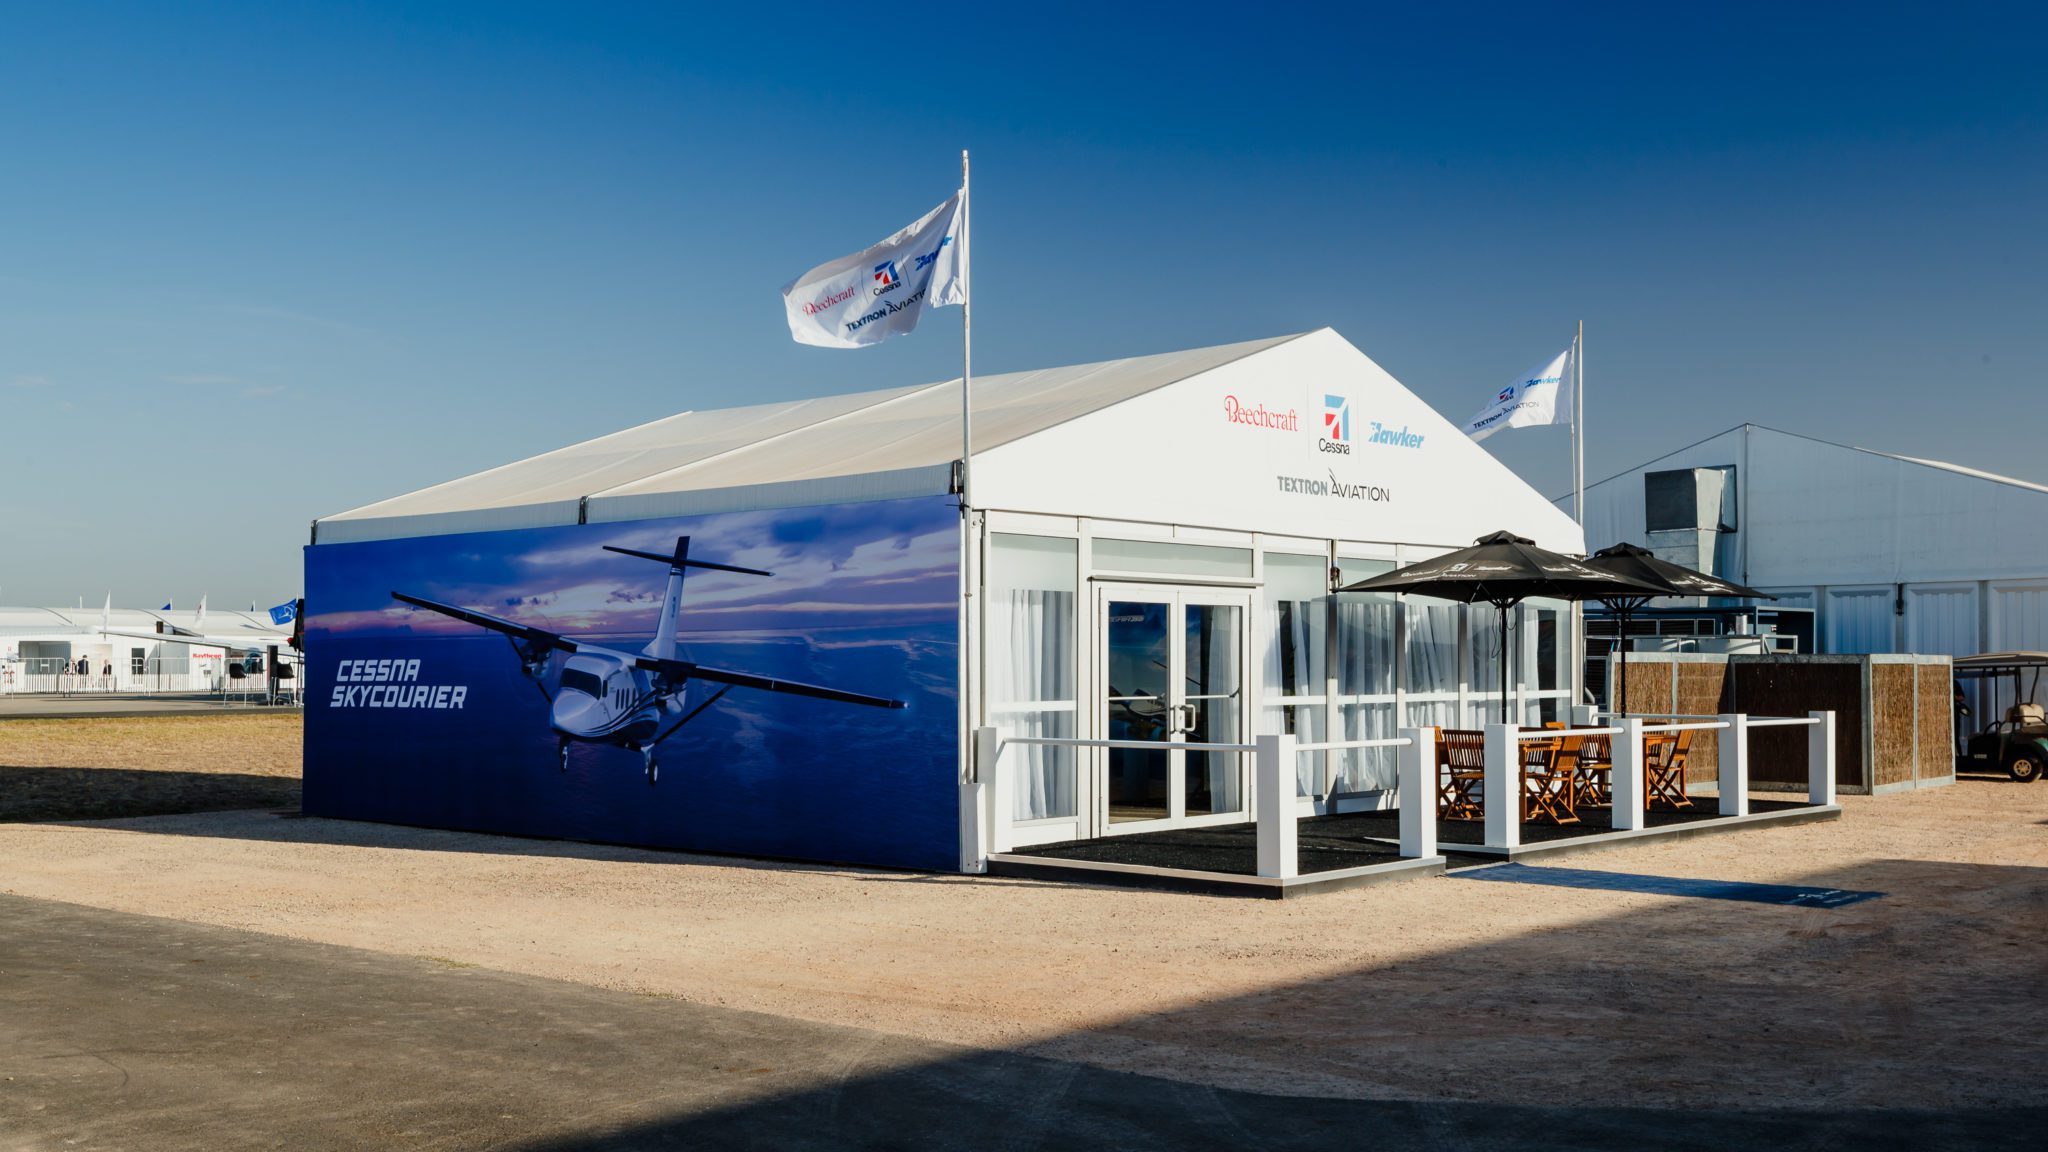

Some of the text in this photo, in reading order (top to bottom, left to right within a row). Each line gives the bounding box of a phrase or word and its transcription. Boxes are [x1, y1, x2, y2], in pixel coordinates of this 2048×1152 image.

[803, 286, 856, 317] Beechcraft
[873, 281, 901, 297] Cessna
[846, 308, 887, 332] TEXTRON
[1224, 395, 1298, 432] Beechcraft
[1473, 401, 1540, 429] TEXTRON AVIATION
[1318, 438, 1350, 455] Cessna
[1368, 421, 1425, 449] Hawker
[1277, 467, 1390, 502] TEXTRON AVIATION
[336, 659, 421, 682] CESSNA
[330, 685, 468, 709] SKYCOURIER
